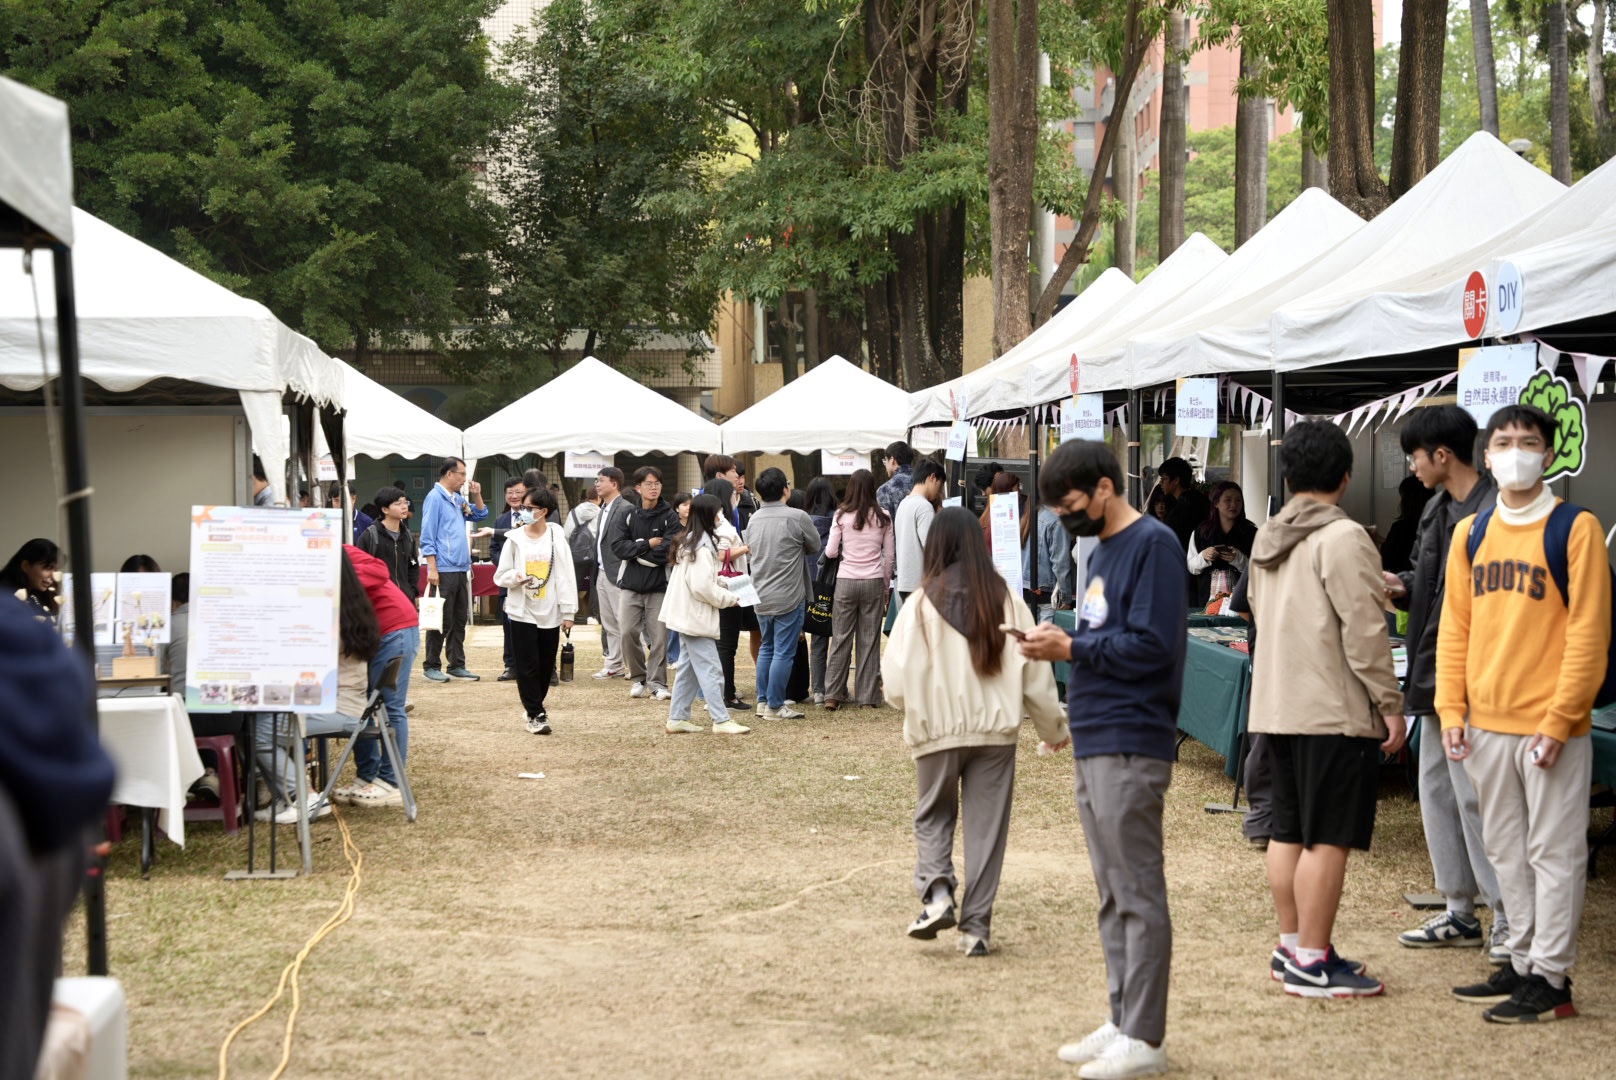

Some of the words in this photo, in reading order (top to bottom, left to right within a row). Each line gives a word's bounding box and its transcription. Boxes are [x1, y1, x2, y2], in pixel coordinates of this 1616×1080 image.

[1464, 288, 1487, 320] 關卡
[1498, 281, 1518, 313] DIY
[1464, 385, 1523, 407] 自然與永續發
[1473, 559, 1547, 601] ROOTS
